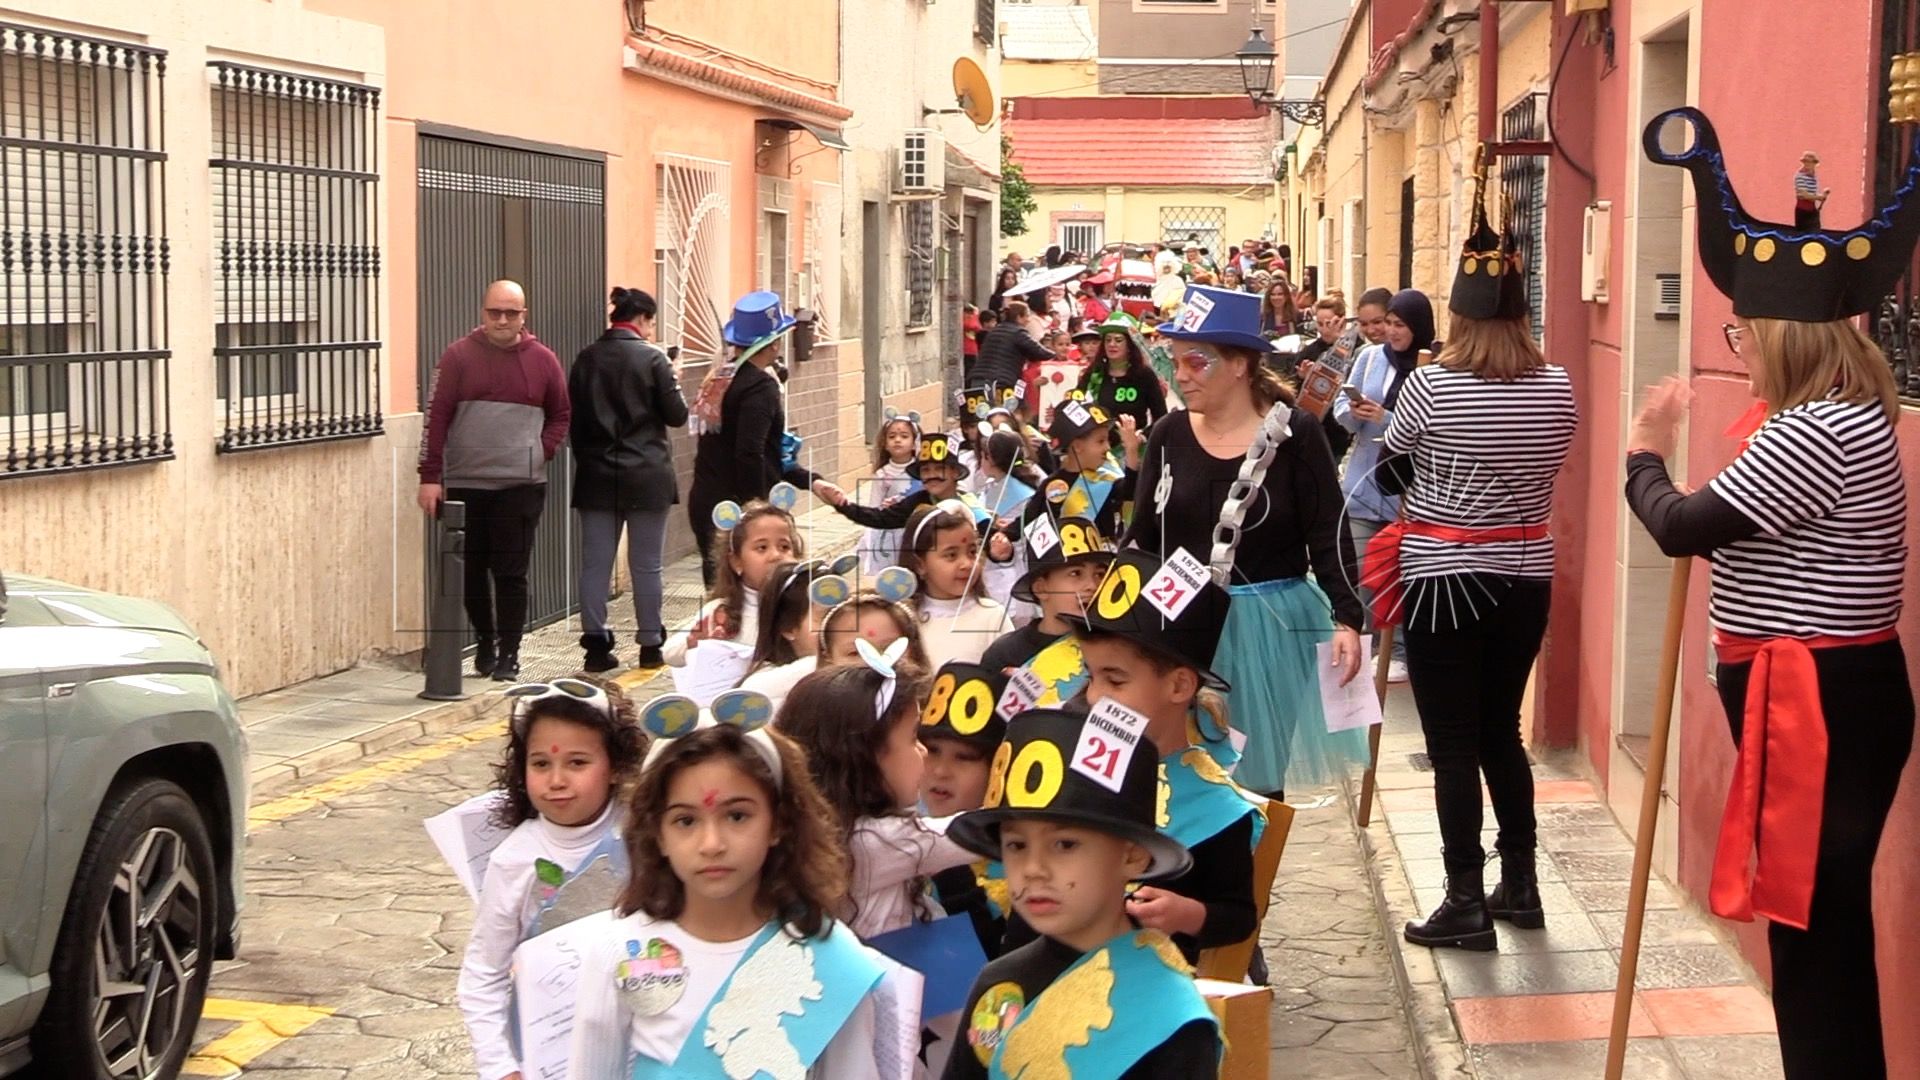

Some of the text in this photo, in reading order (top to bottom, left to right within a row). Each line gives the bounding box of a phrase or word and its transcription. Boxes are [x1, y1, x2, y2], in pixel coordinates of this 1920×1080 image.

[1184, 310, 1201, 329] 21
[1114, 387, 1138, 402] 80
[919, 439, 948, 461] 80
[1182, 555, 1204, 577] 1872
[1150, 576, 1186, 610] 21
[921, 673, 995, 736] 80
[1104, 703, 1138, 727] 1872
[1088, 713, 1139, 746] DICIEMBRE
[1081, 737, 1122, 780] 21
[983, 740, 1064, 808] 80
